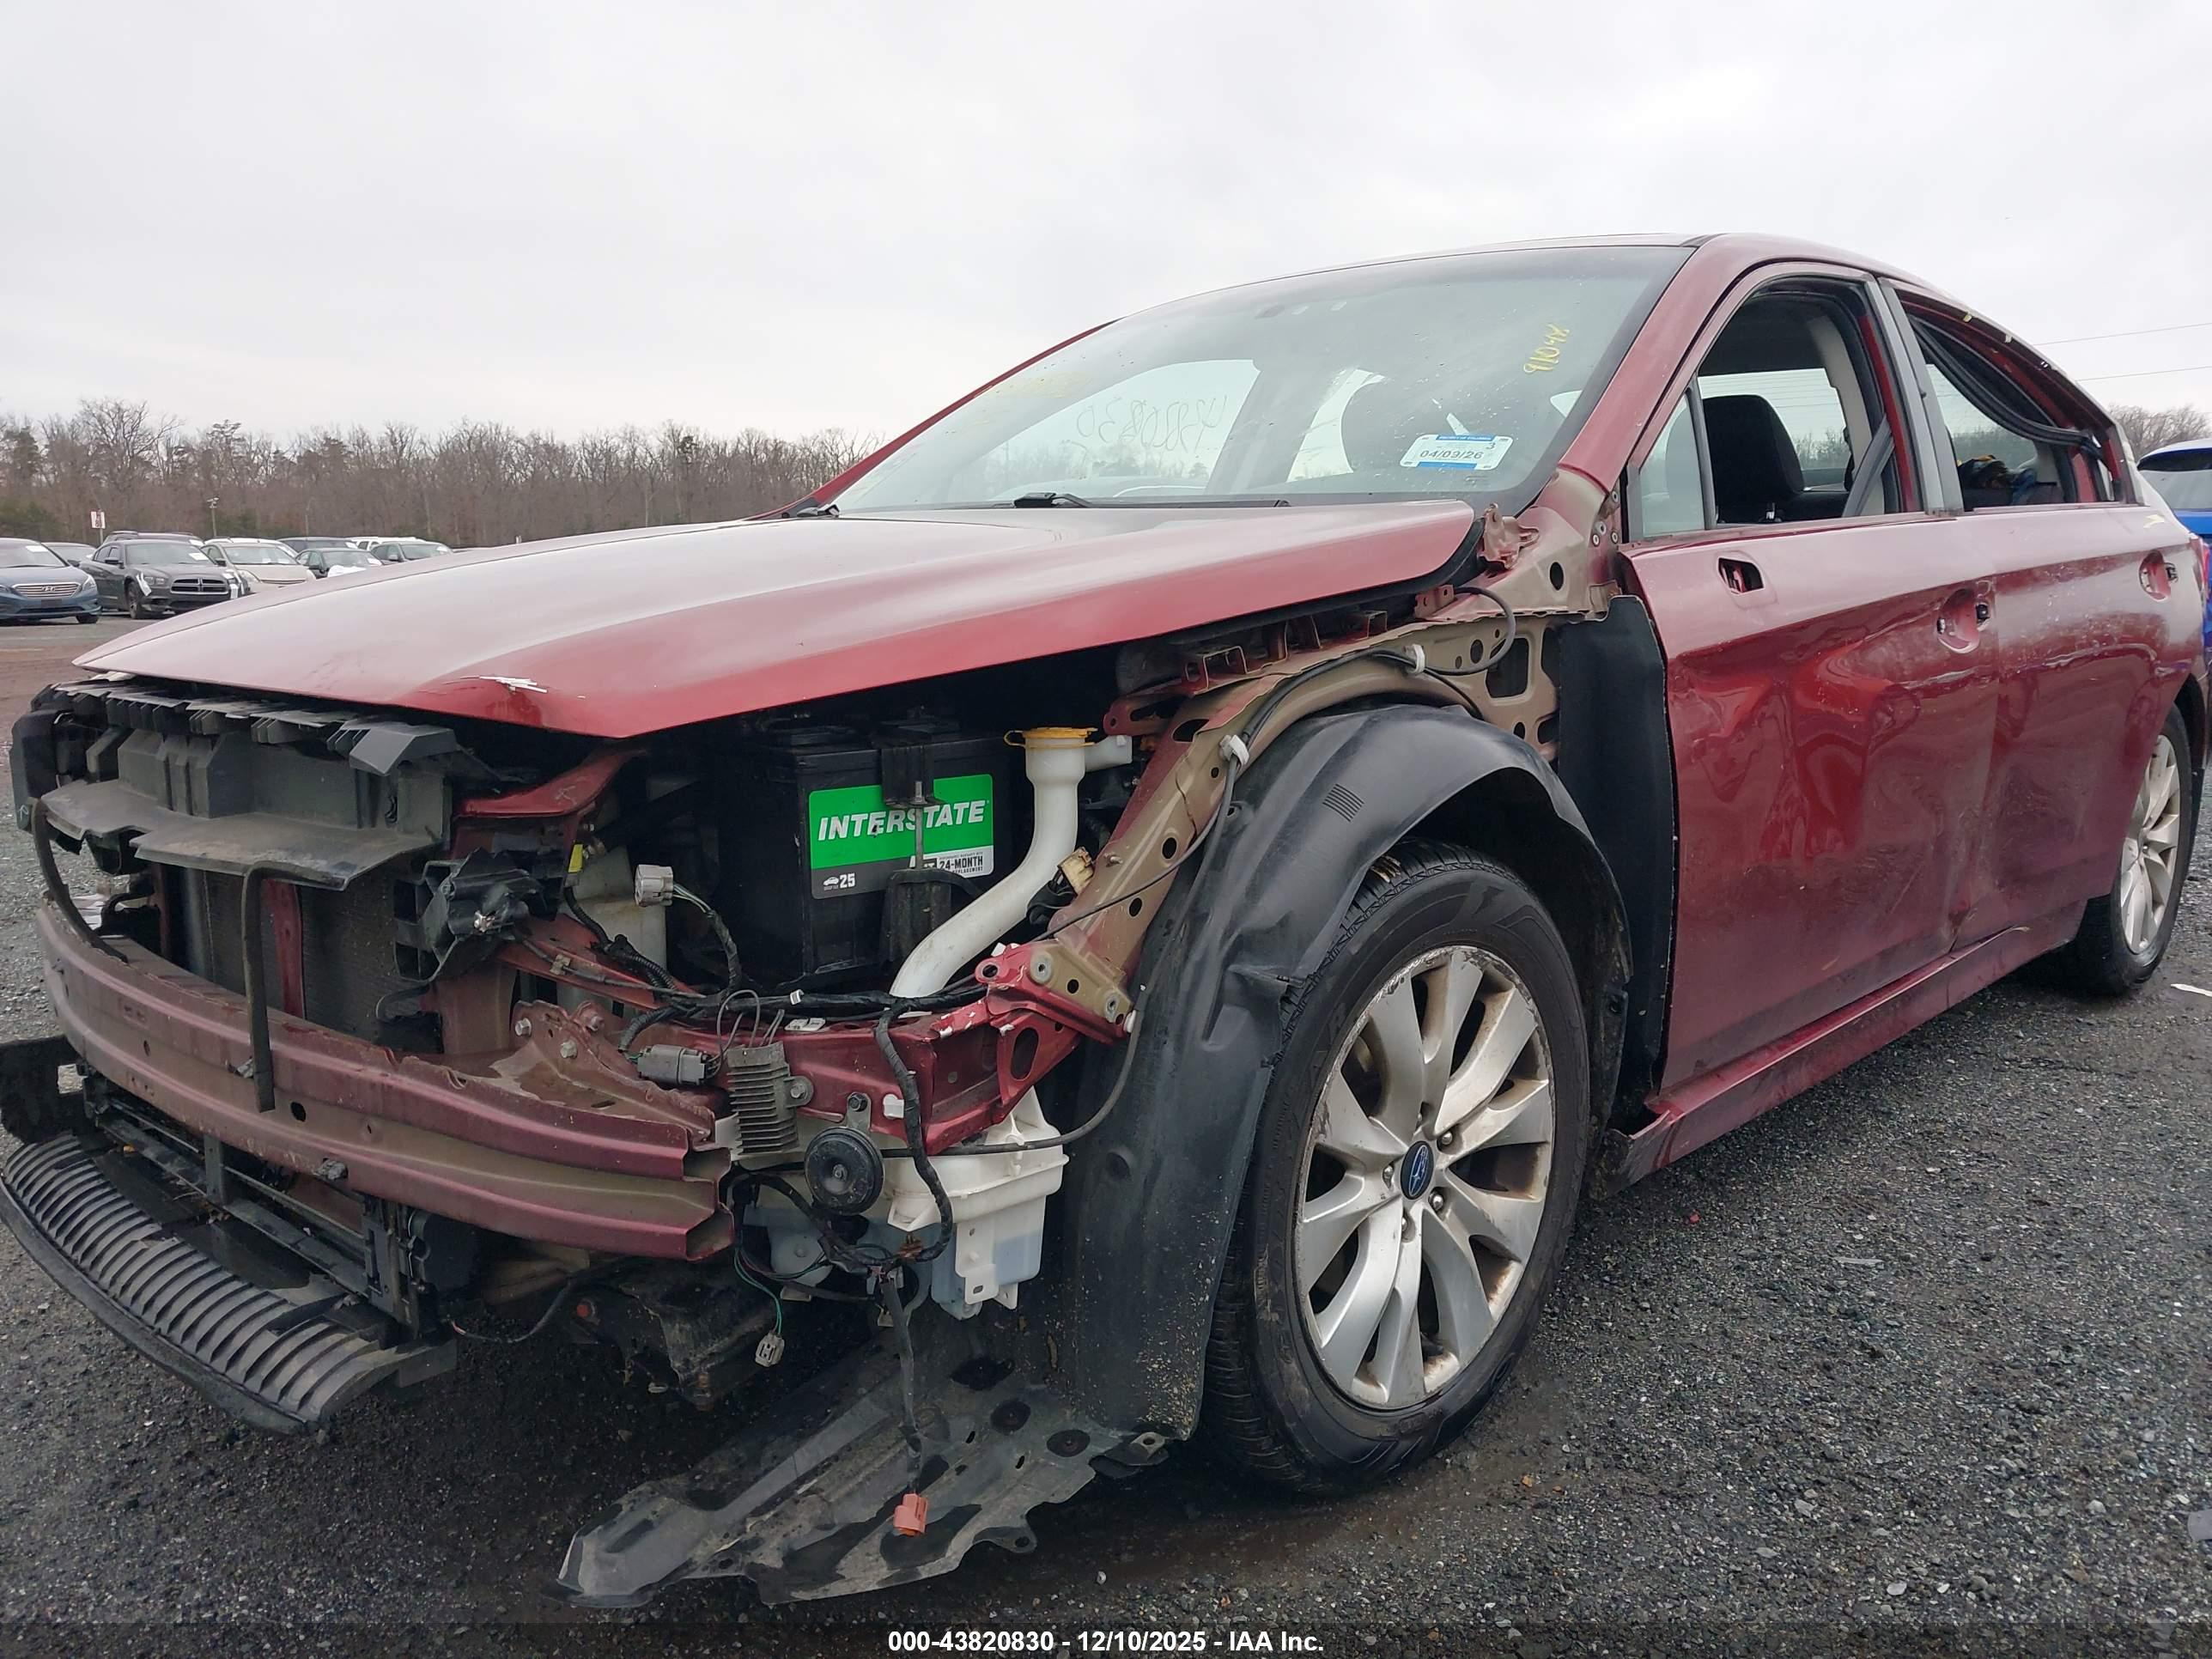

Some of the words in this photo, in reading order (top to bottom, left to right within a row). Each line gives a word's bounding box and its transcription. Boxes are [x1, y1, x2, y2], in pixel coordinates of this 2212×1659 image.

[817, 799, 987, 841] INTERSTATE
[939, 855, 983, 870] 24-MONTH
[839, 872, 856, 890] 25
